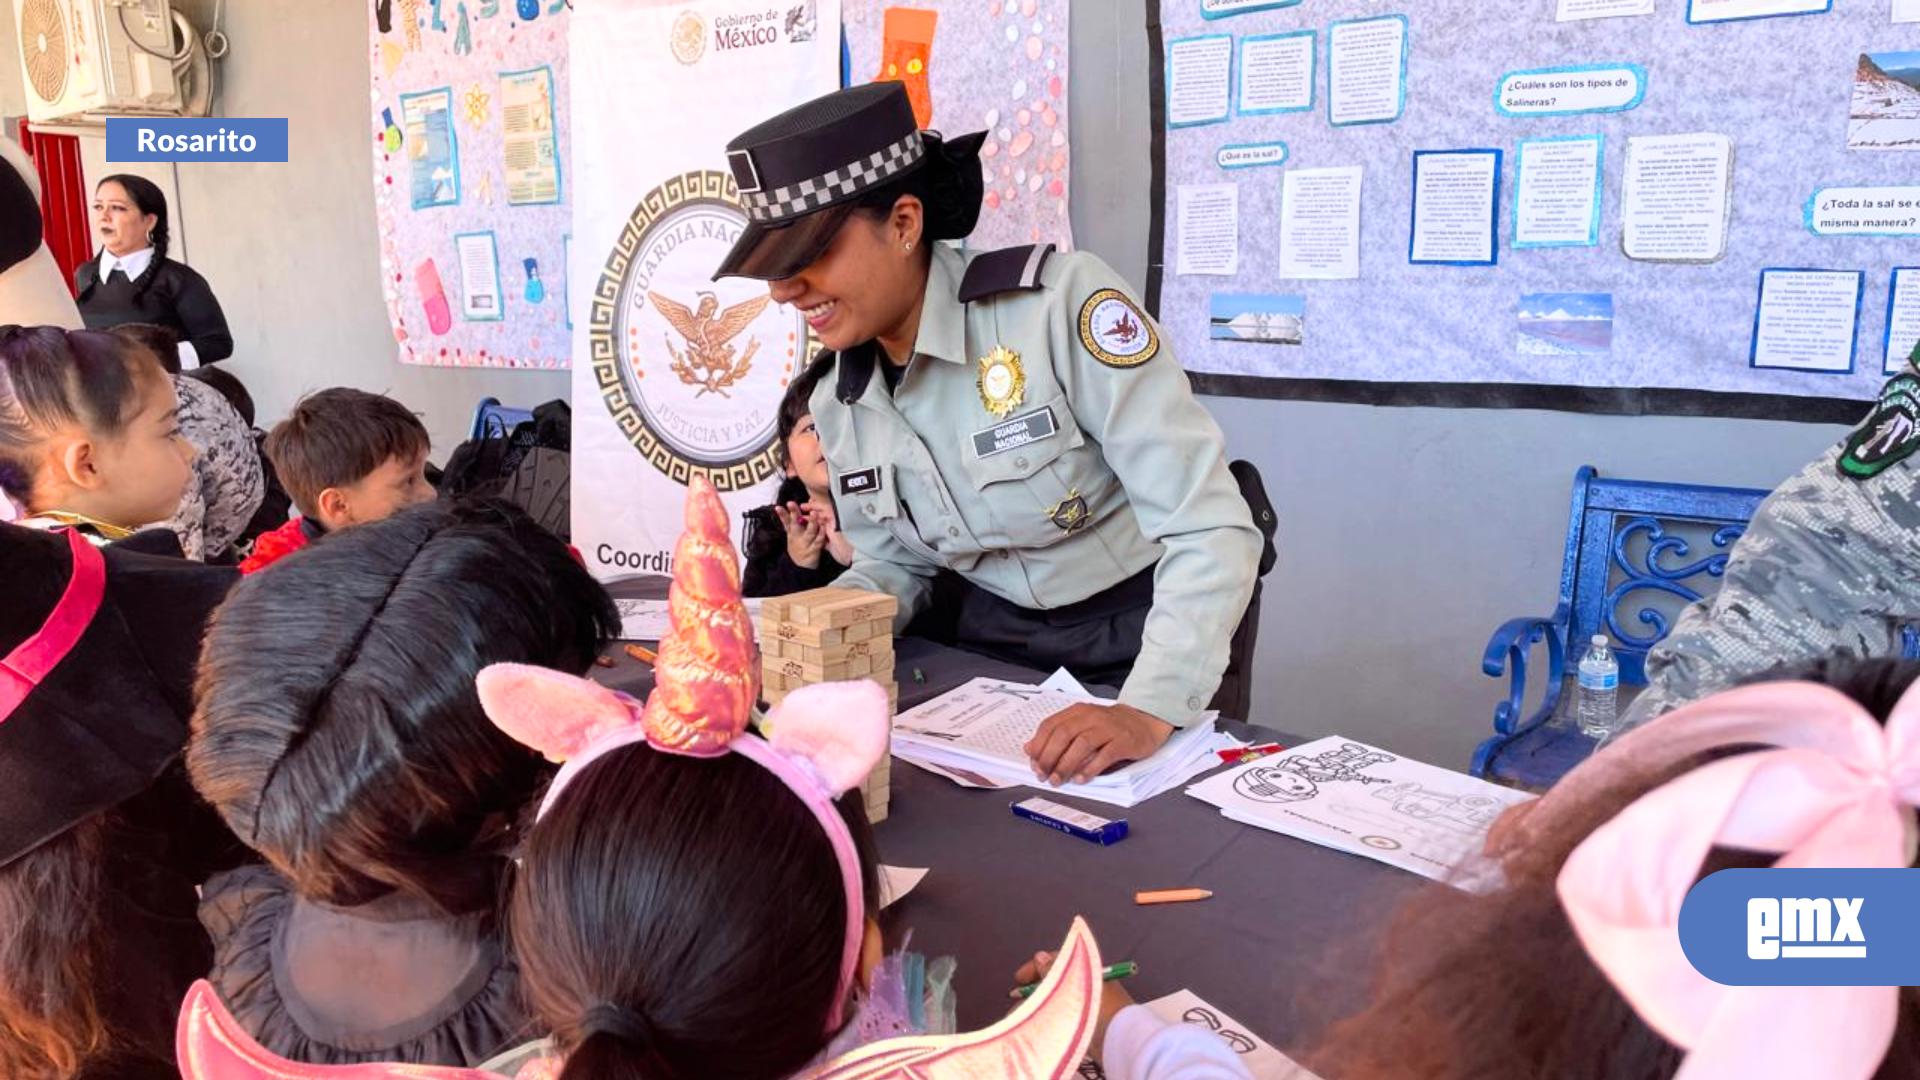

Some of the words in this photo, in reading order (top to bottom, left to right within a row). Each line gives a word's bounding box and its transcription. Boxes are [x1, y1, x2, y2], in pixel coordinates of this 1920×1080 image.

[715, 13, 763, 29] Gobierno
[766, 9, 779, 22] de
[715, 23, 777, 51] México
[1507, 80, 1546, 92] ¿Cuáles
[1549, 81, 1567, 89] son
[1570, 79, 1585, 88] los
[1588, 77, 1612, 91] tipos
[1615, 77, 1628, 87] de
[1506, 98, 1557, 107] Salineras?
[1821, 199, 1860, 212] ¿Toda
[1862, 199, 1873, 209] la
[1877, 198, 1895, 209] sal
[1897, 200, 1912, 209] se
[1820, 217, 1860, 228] misma
[1863, 217, 1917, 228] manera?
[633, 222, 697, 310] GUARDIA
[700, 220, 741, 246] NAC
[656, 402, 719, 444] JUSTICIA
[721, 425, 731, 441] Y
[735, 408, 765, 438] PAZ
[994, 419, 1029, 440] GUARDIA
[994, 430, 1033, 451] NACIONAL
[596, 543, 674, 574] Coordi
